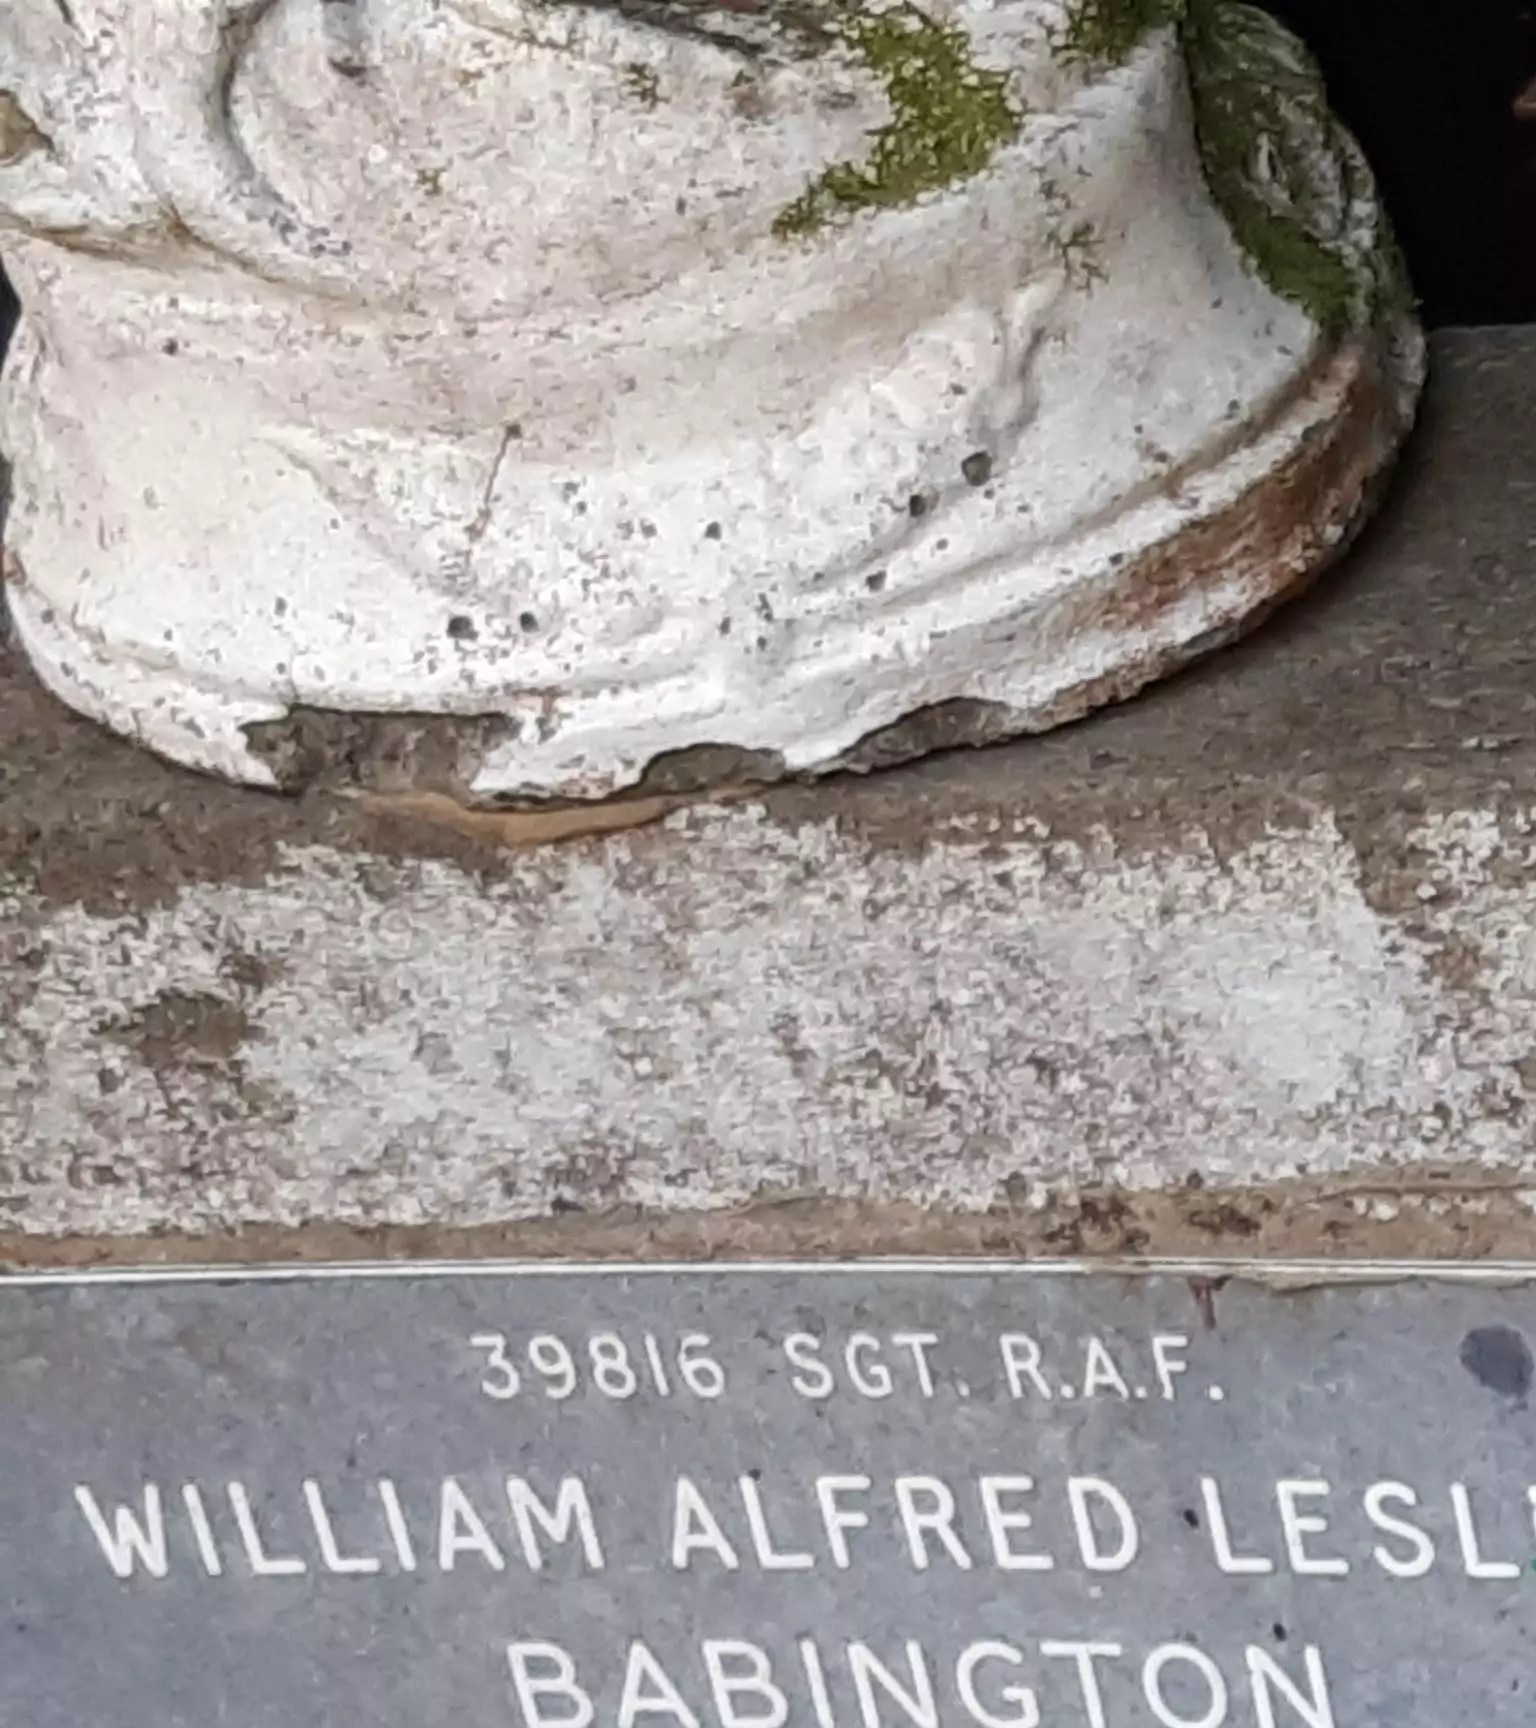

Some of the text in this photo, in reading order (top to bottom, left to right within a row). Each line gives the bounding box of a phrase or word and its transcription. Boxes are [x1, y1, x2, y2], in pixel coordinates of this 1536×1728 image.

[470, 1331, 1225, 1401] 39816 SGT. R.A.F.
[73, 1476, 605, 1578] WILLIAM
[671, 1474, 1138, 1571] ALFRED
